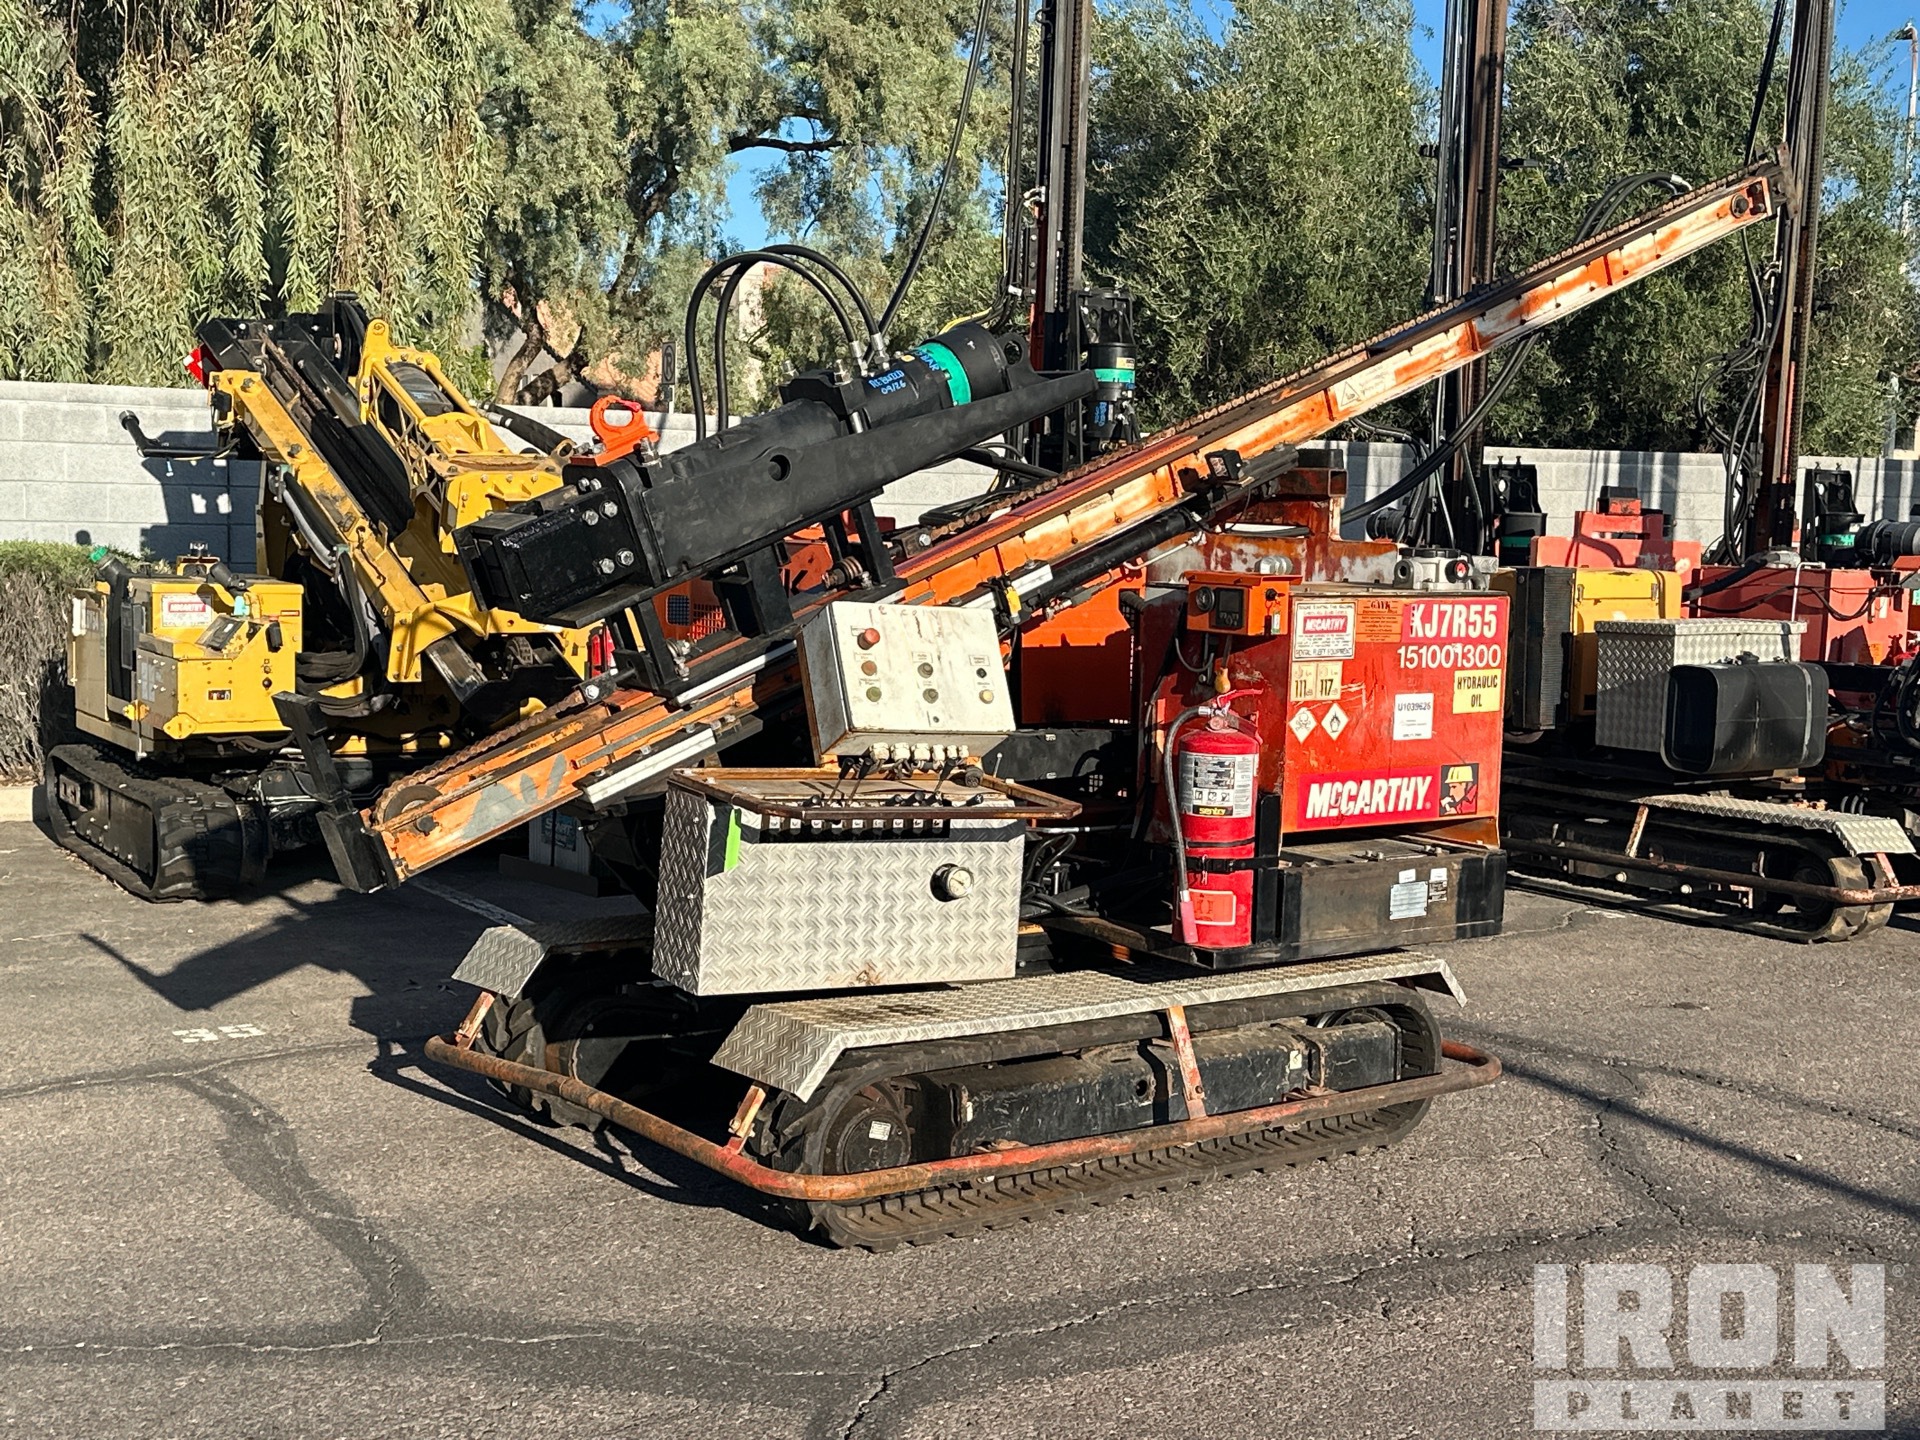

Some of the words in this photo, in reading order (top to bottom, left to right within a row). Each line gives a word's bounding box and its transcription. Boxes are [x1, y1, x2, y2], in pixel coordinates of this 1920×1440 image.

[1410, 604, 1498, 639] KJ7R55
[1397, 643, 1502, 669] 151001300
[1320, 678, 1334, 696] 117
[1457, 674, 1498, 690] HYDRAULIC
[1471, 693, 1482, 707] OIL
